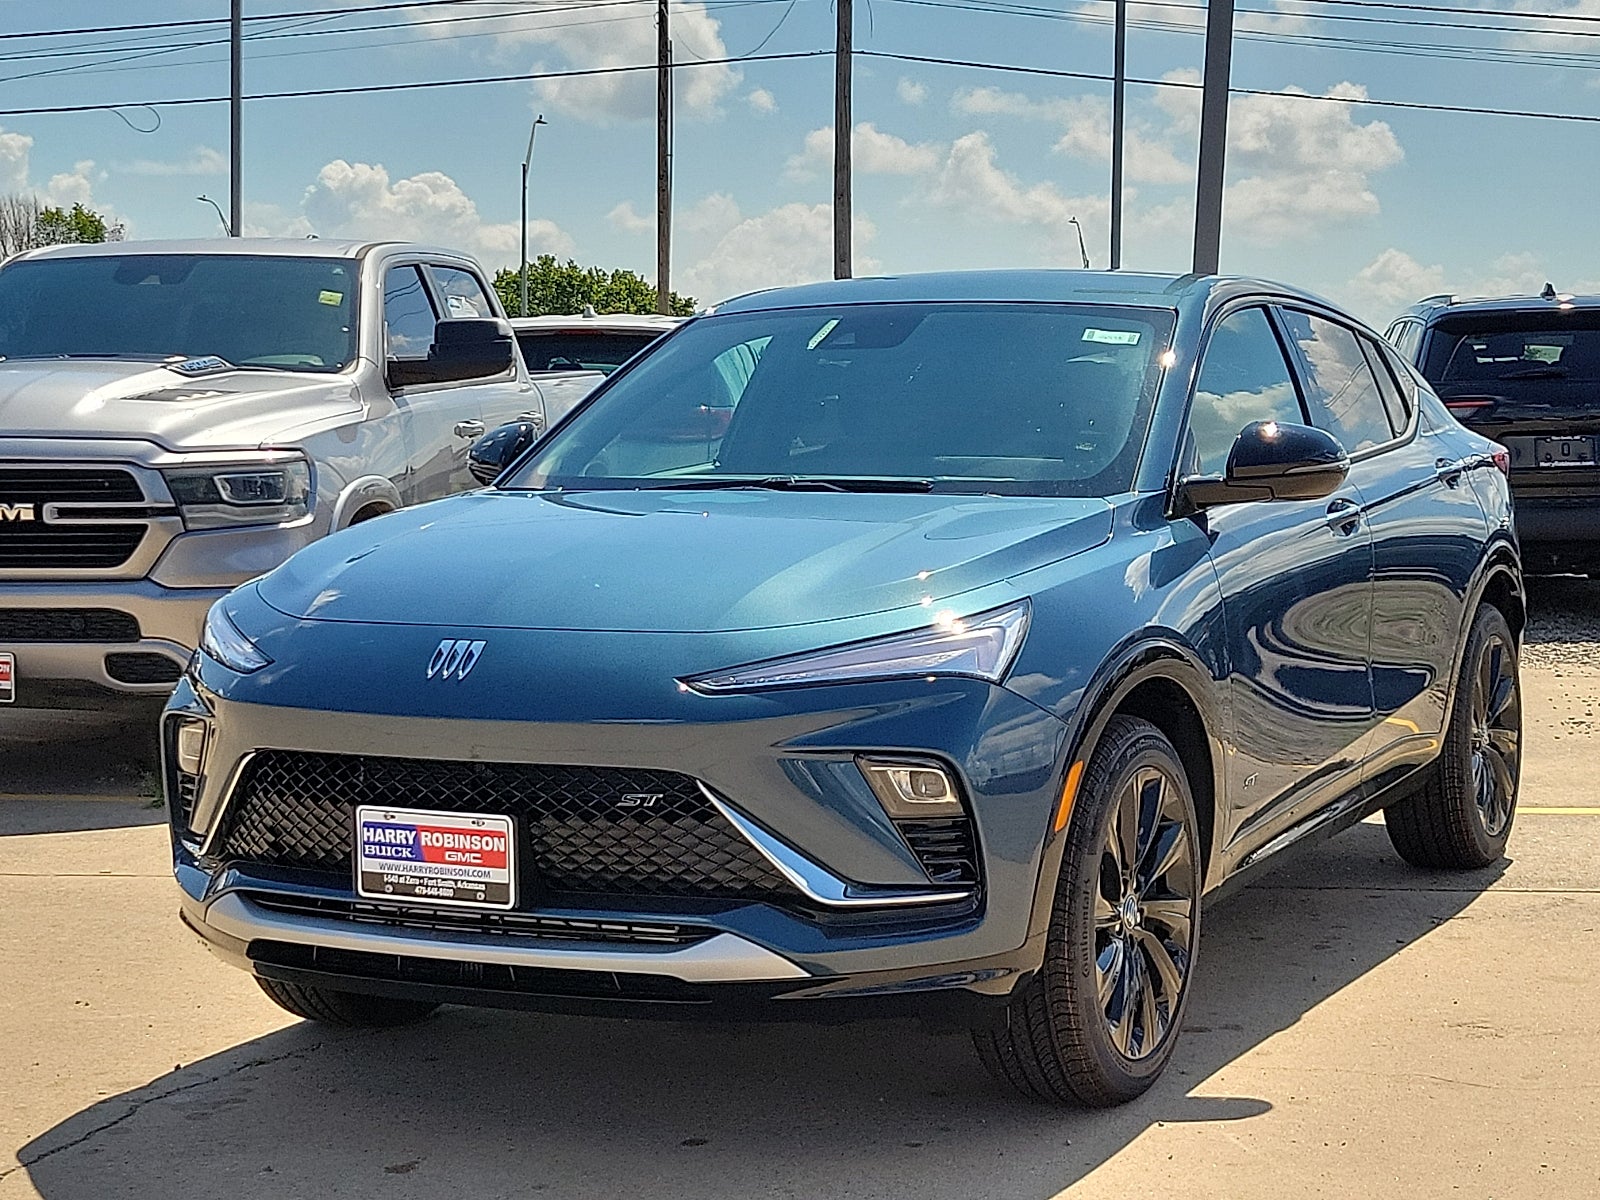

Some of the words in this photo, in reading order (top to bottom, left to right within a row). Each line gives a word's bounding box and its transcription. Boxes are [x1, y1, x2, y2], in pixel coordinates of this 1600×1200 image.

[615, 793, 664, 807] ST
[363, 827, 417, 845] HARRY
[421, 831, 505, 852] ROBINSON
[445, 851, 483, 863] GMC
[379, 862, 491, 878] WWW.HARRYROBINSON.COM
